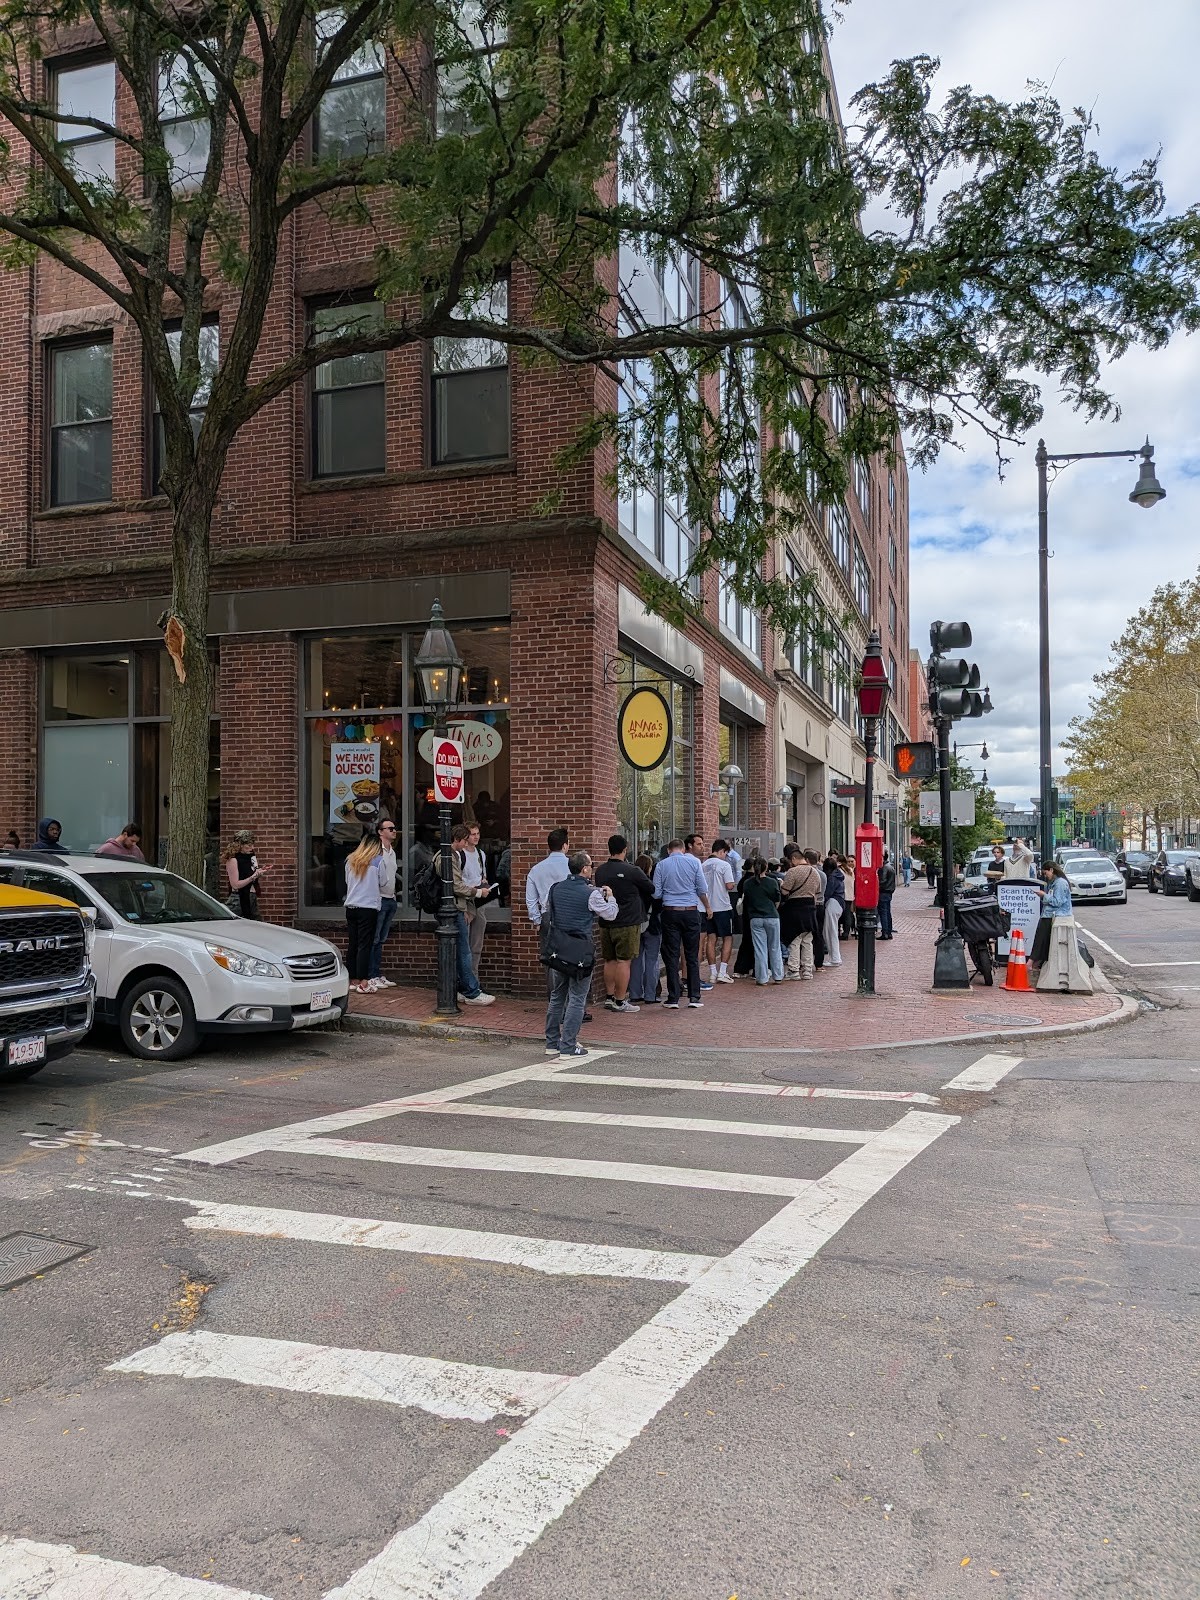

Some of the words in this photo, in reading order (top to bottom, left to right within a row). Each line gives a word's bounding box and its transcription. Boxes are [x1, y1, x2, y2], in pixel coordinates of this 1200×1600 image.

[335, 754, 351, 762] WE
[353, 754, 375, 762] HAVE
[437, 753, 447, 763] DO
[447, 755, 459, 765] NOT
[335, 764, 375, 775] QUESO!
[440, 778, 459, 788] ENTER
[735, 837, 750, 846] 242
